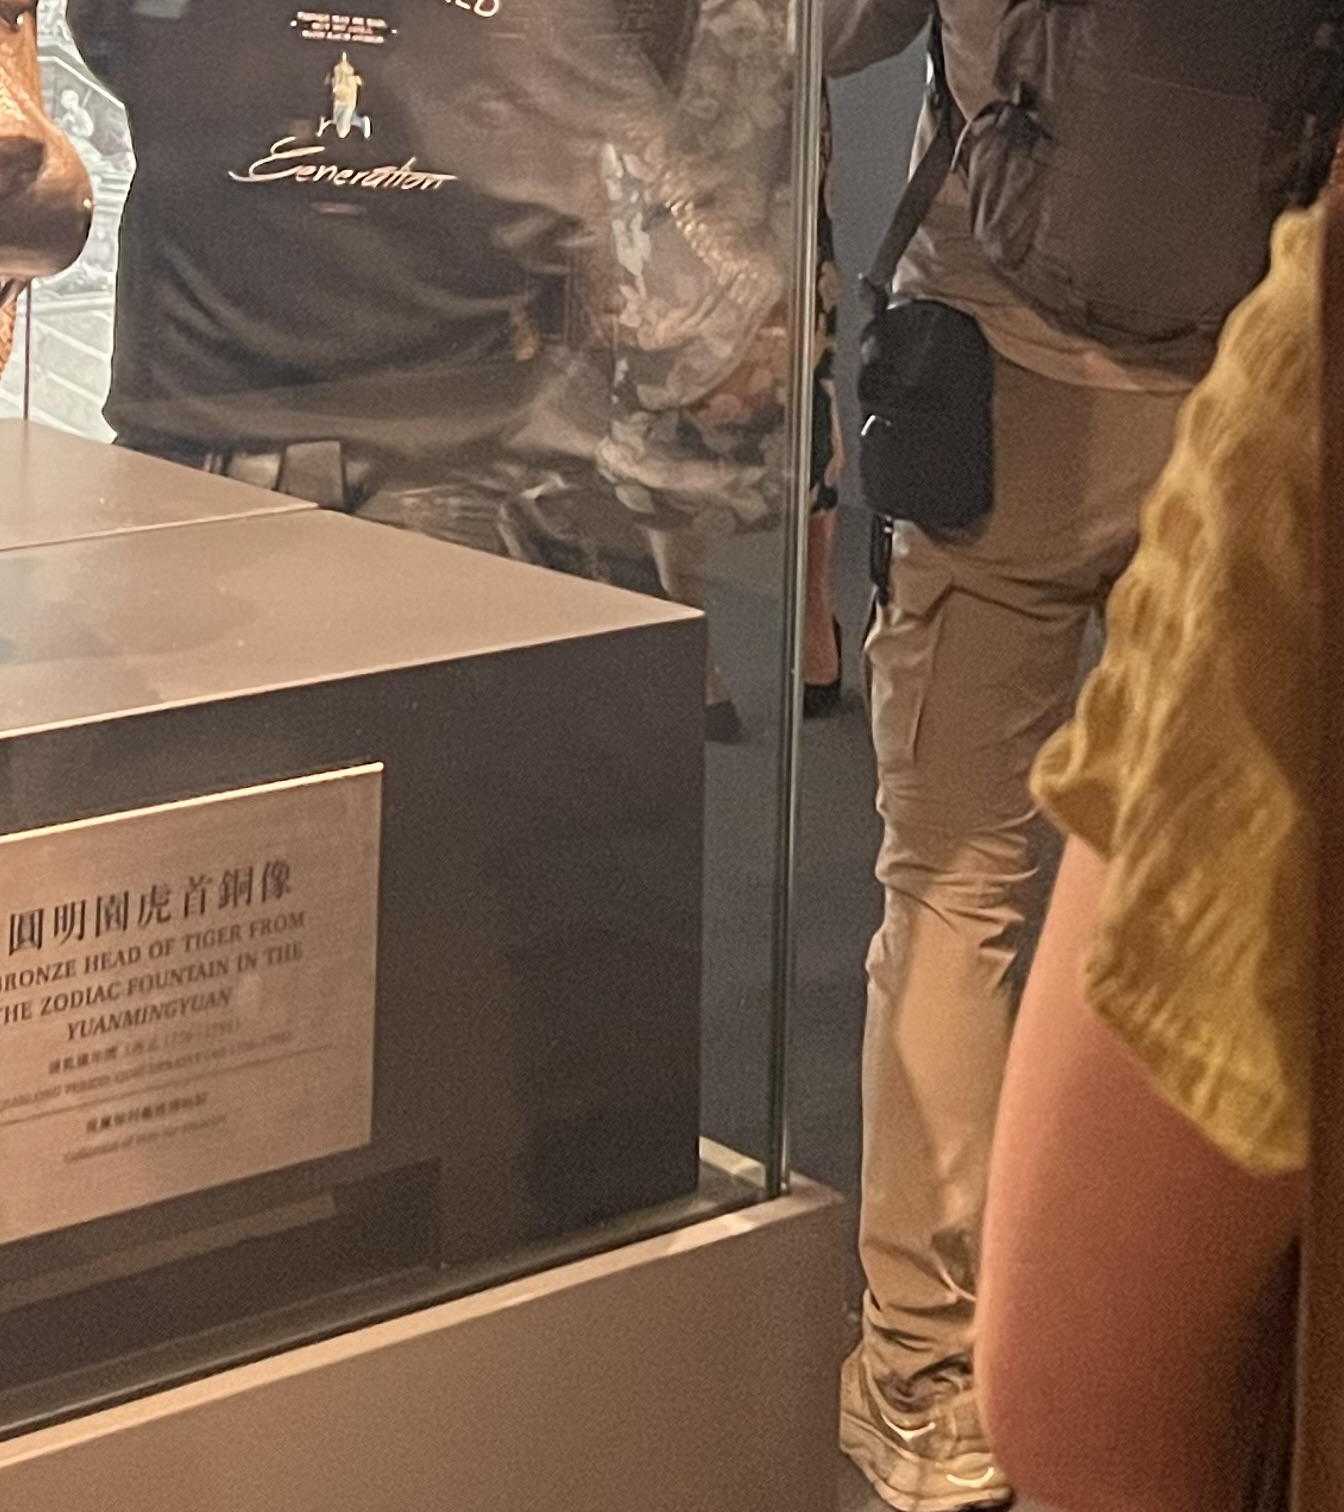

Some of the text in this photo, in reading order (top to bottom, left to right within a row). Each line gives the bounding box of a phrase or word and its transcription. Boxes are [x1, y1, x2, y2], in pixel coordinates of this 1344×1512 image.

[8, 858, 290, 957] 圓明園虎首銅像
[85, 945, 141, 975] HEAD
[149, 938, 176, 959] OF
[185, 926, 243, 953] TIGER
[250, 911, 305, 938] FROM
[40, 981, 121, 1017] ZODIAC
[129, 958, 230, 996] FOUNTAIN
[237, 952, 258, 972] IN
[266, 942, 304, 966] THE
[67, 987, 233, 1043] YUANMINGYUAN
